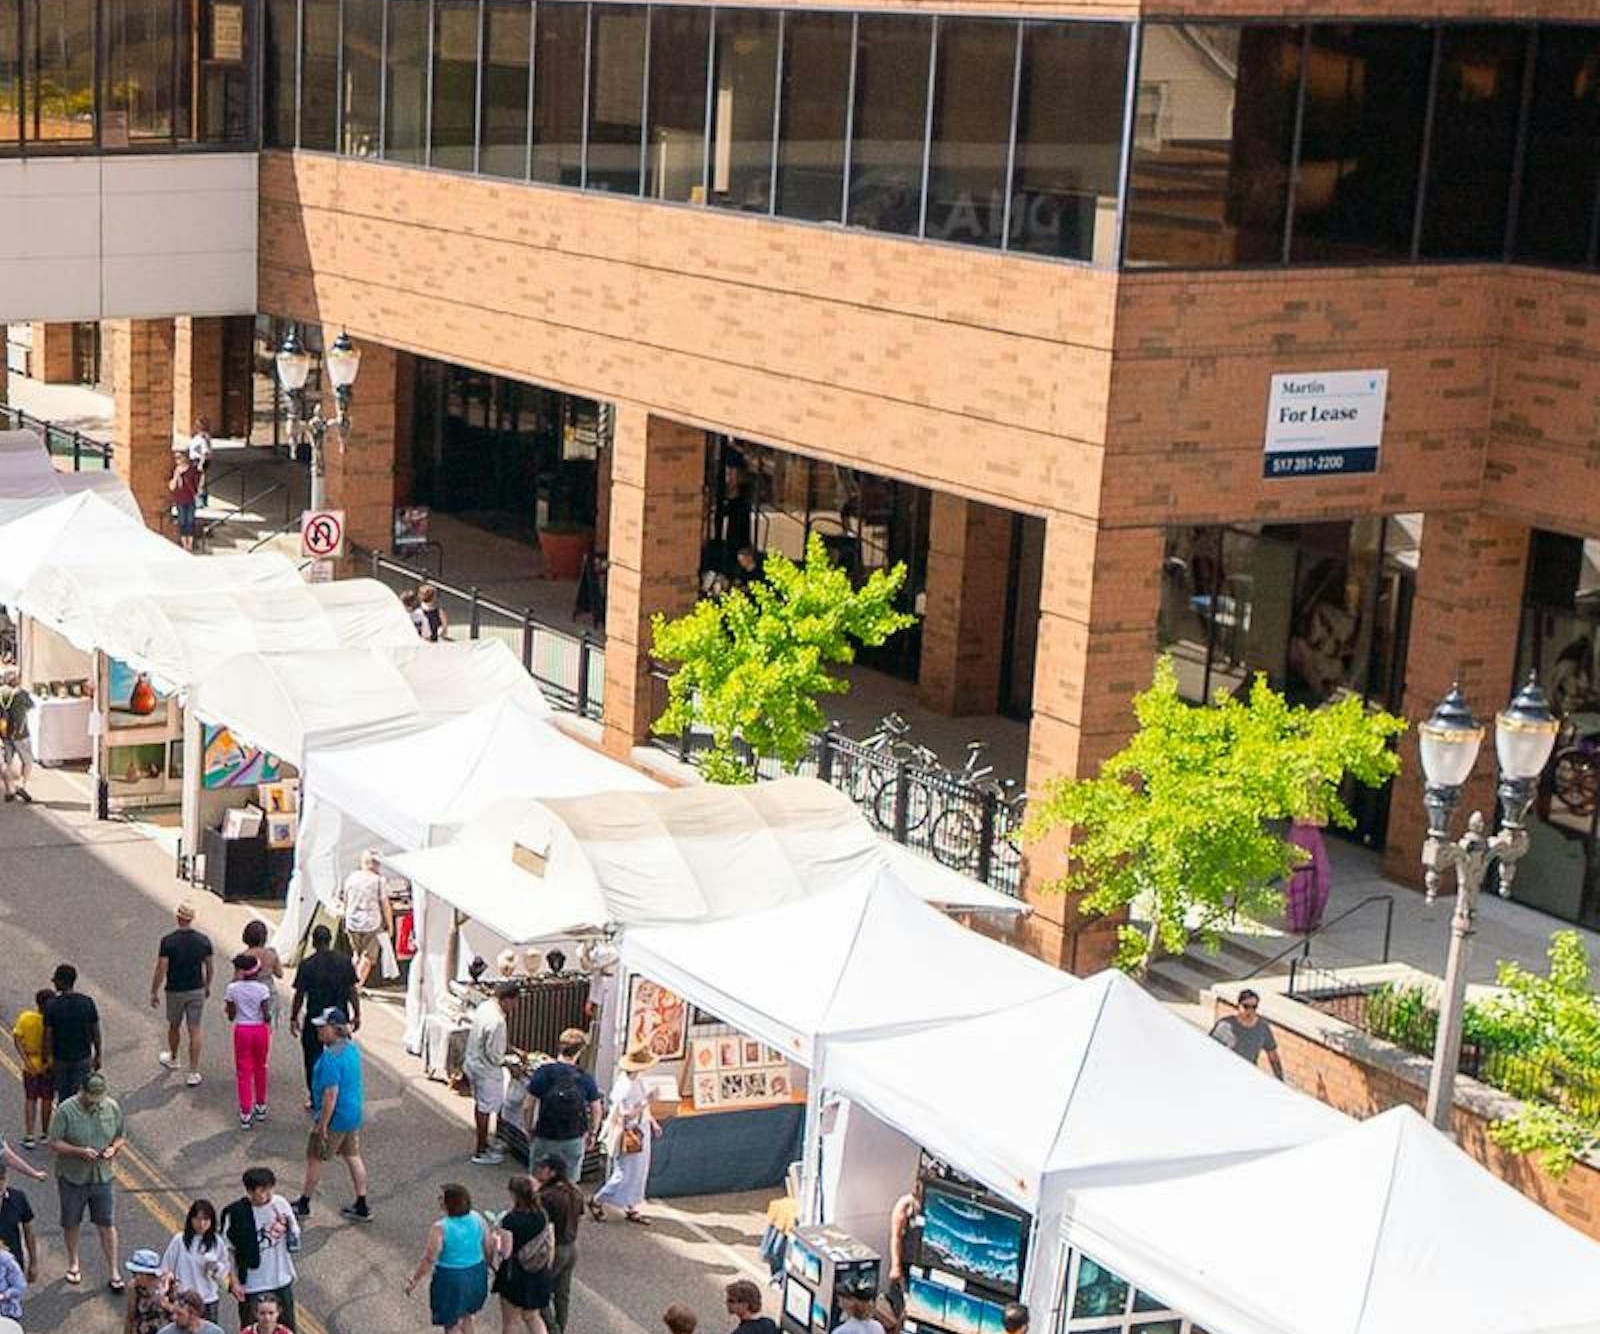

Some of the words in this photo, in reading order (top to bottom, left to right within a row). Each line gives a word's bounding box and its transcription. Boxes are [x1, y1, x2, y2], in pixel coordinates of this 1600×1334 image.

[1281, 379, 1325, 394] Martin
[1279, 407, 1306, 423] For
[1311, 406, 1358, 422] Lease
